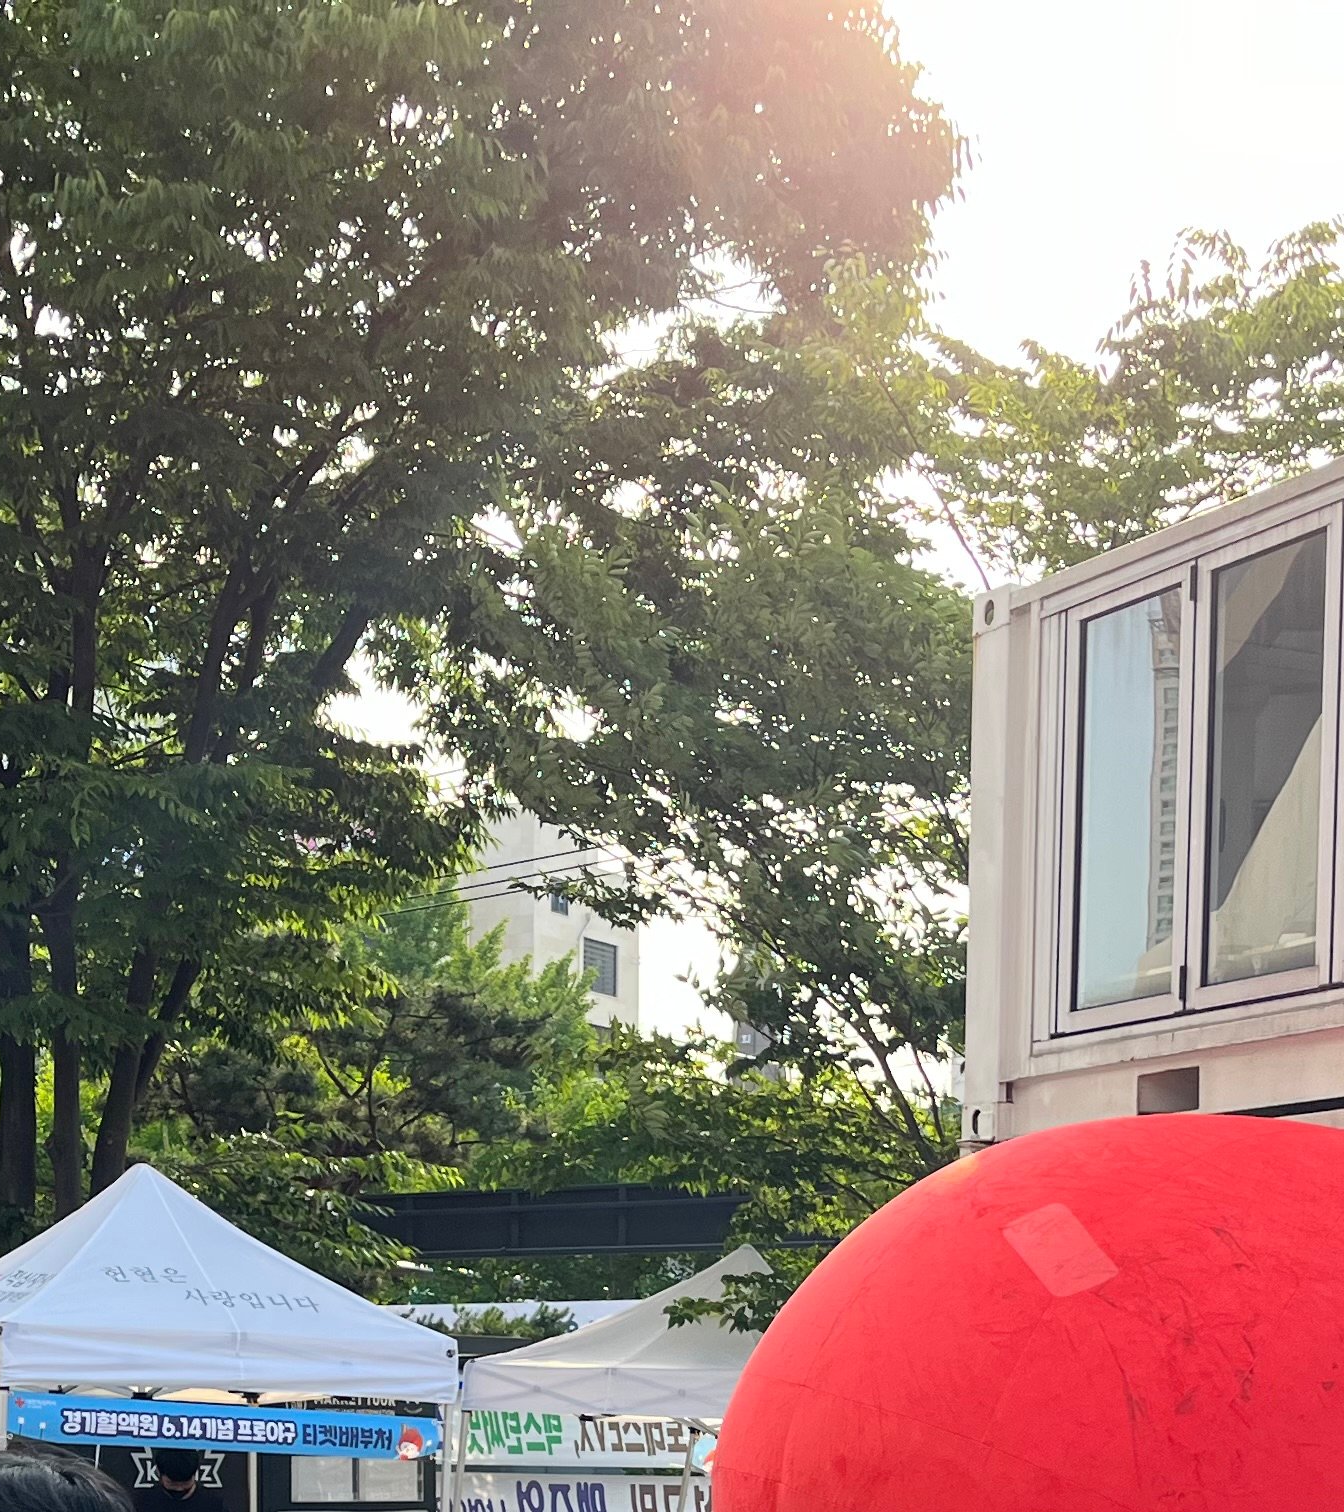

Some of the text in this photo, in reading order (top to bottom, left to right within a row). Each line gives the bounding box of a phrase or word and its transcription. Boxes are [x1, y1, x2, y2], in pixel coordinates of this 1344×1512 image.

[185, 1287, 320, 1313] 사랑입니다
[62, 1410, 392, 1451] 경기혈액원 6.14기념 프로야구 티켓배부처
